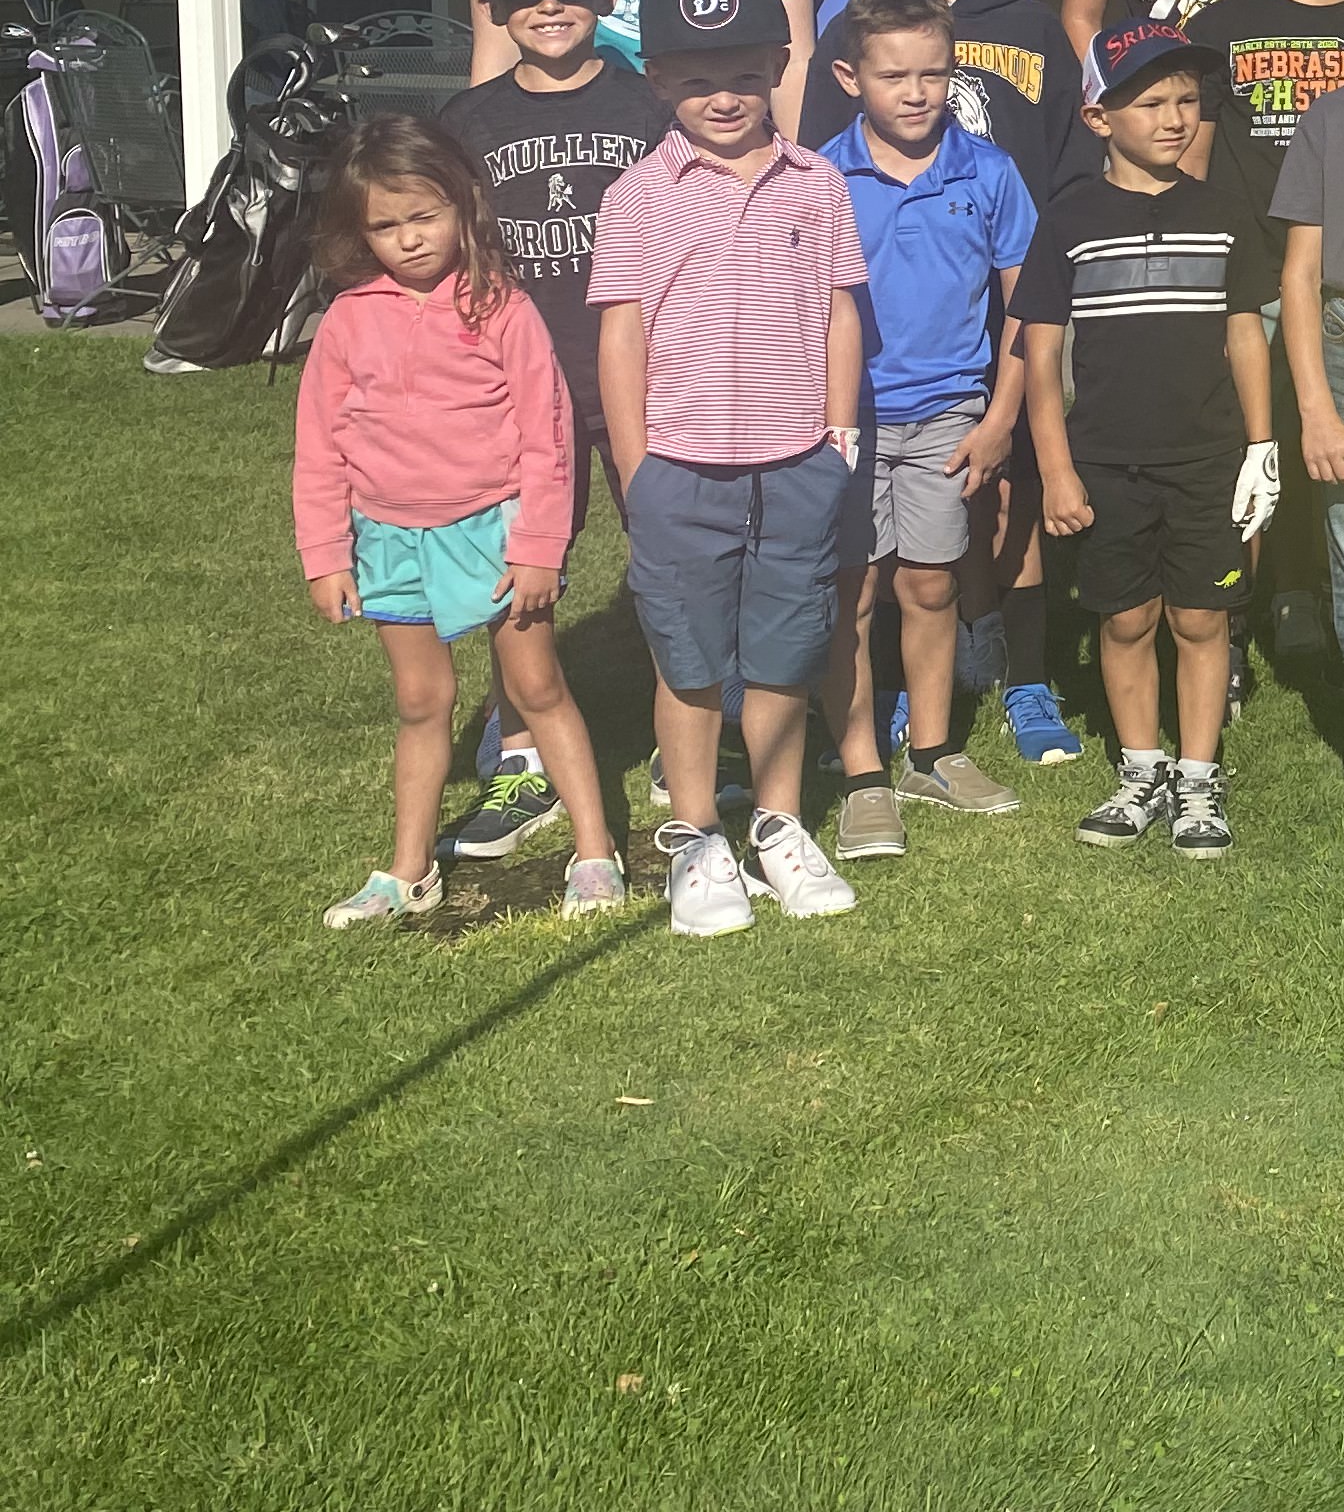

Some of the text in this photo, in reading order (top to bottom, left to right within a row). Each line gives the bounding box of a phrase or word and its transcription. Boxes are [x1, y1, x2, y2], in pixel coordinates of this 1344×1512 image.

[954, 40, 1045, 105] BRONCOS
[1250, 79, 1293, 112] 4-H
[484, 133, 646, 187] MULLEN
